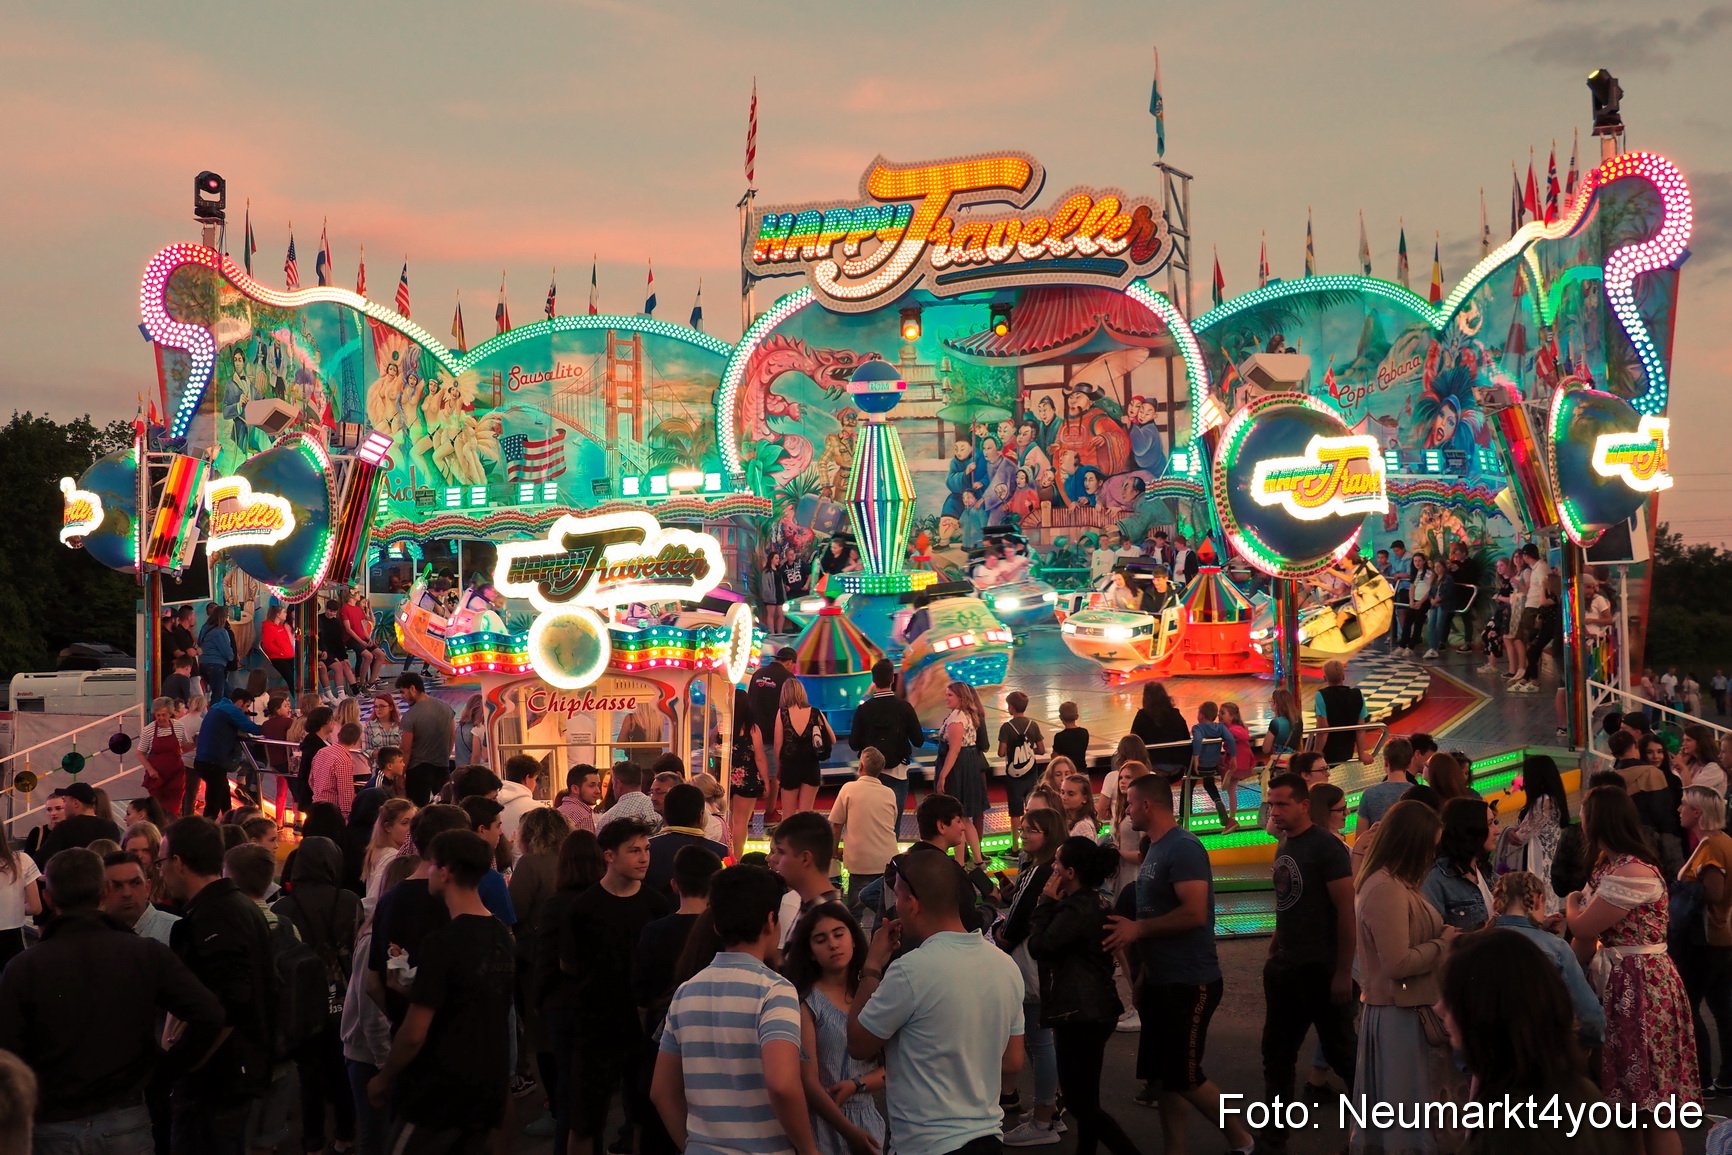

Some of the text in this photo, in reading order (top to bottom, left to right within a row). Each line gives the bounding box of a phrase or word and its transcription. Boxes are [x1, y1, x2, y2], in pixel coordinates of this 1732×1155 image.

[751, 157, 1162, 299] HAPPY Traveller
[507, 361, 584, 392] Sausalito
[1337, 355, 1422, 410] Copa Cabana
[507, 526, 711, 603] HAPPY Traveller
[527, 690, 637, 720] Chipkasse
